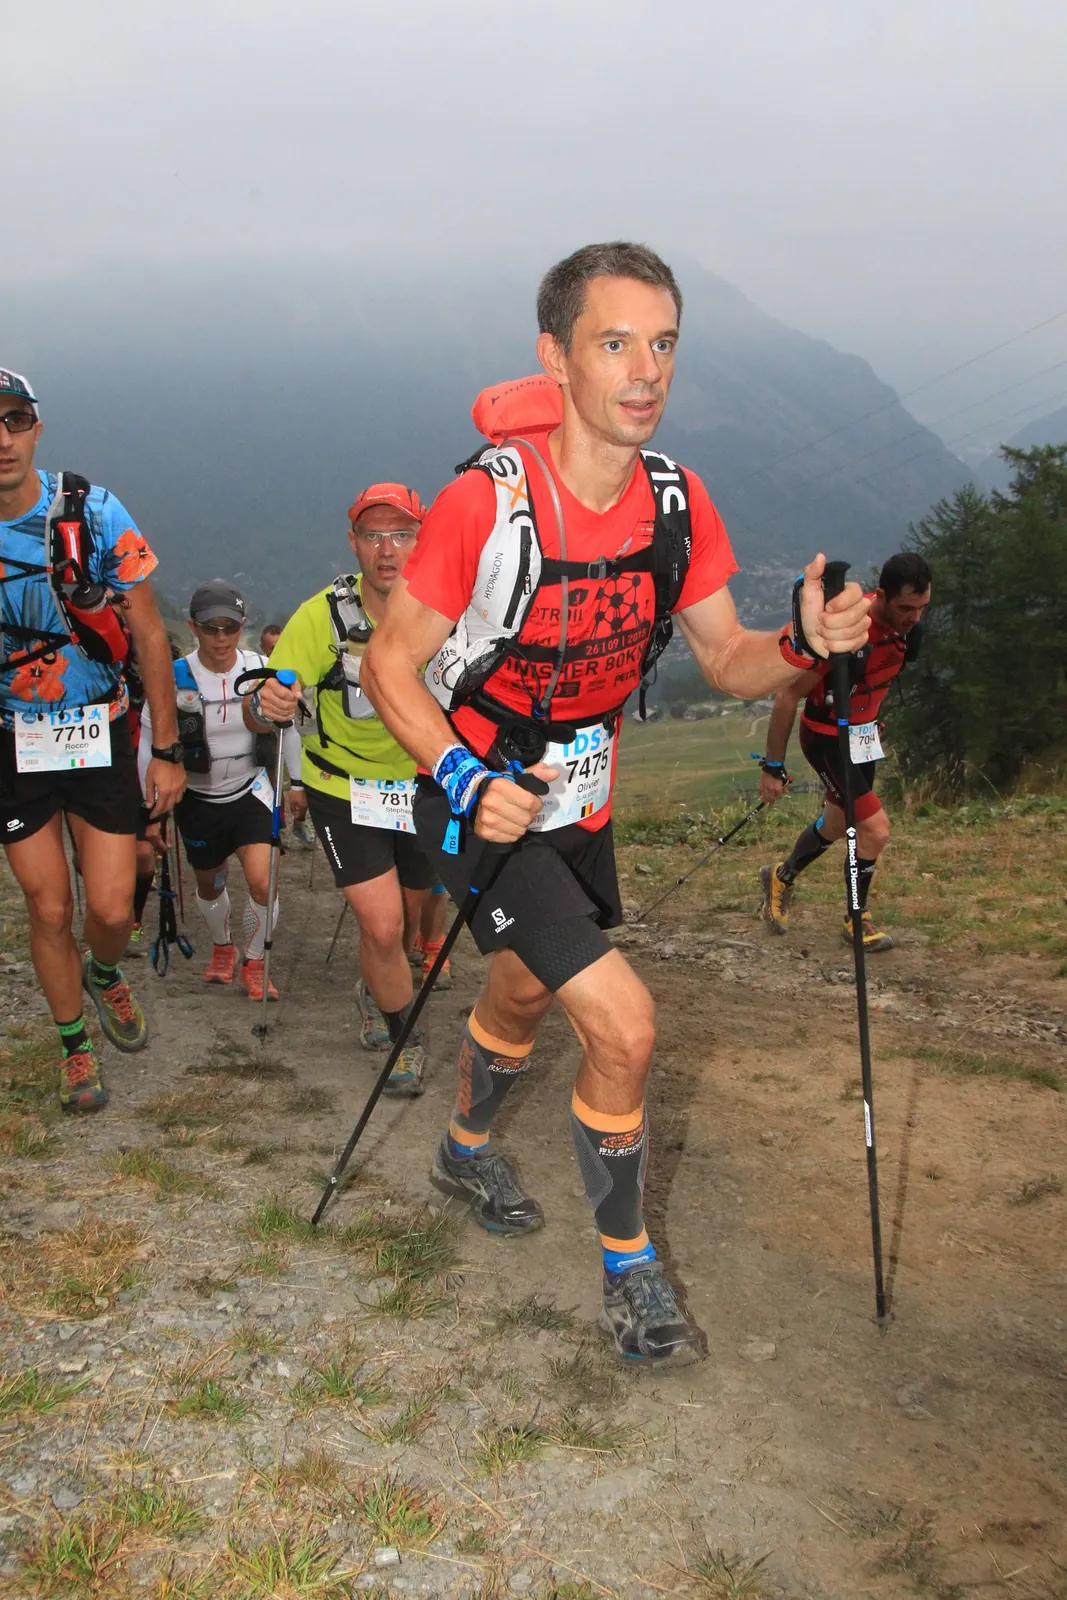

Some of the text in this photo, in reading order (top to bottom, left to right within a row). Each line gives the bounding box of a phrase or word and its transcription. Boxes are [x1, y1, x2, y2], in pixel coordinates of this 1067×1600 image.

[484, 551, 504, 601] HYDRAGON
[586, 645, 599, 656] 26
[608, 638, 619, 650] 09
[48, 708, 84, 727] TDS
[53, 724, 100, 743] 7710
[859, 732, 875, 746] 704
[456, 764, 468, 777] TDS
[565, 746, 609, 784] 7475
[577, 778, 600, 793] Olivier
[449, 835, 457, 849] TDS
[848, 839, 860, 910] Black Diamond
